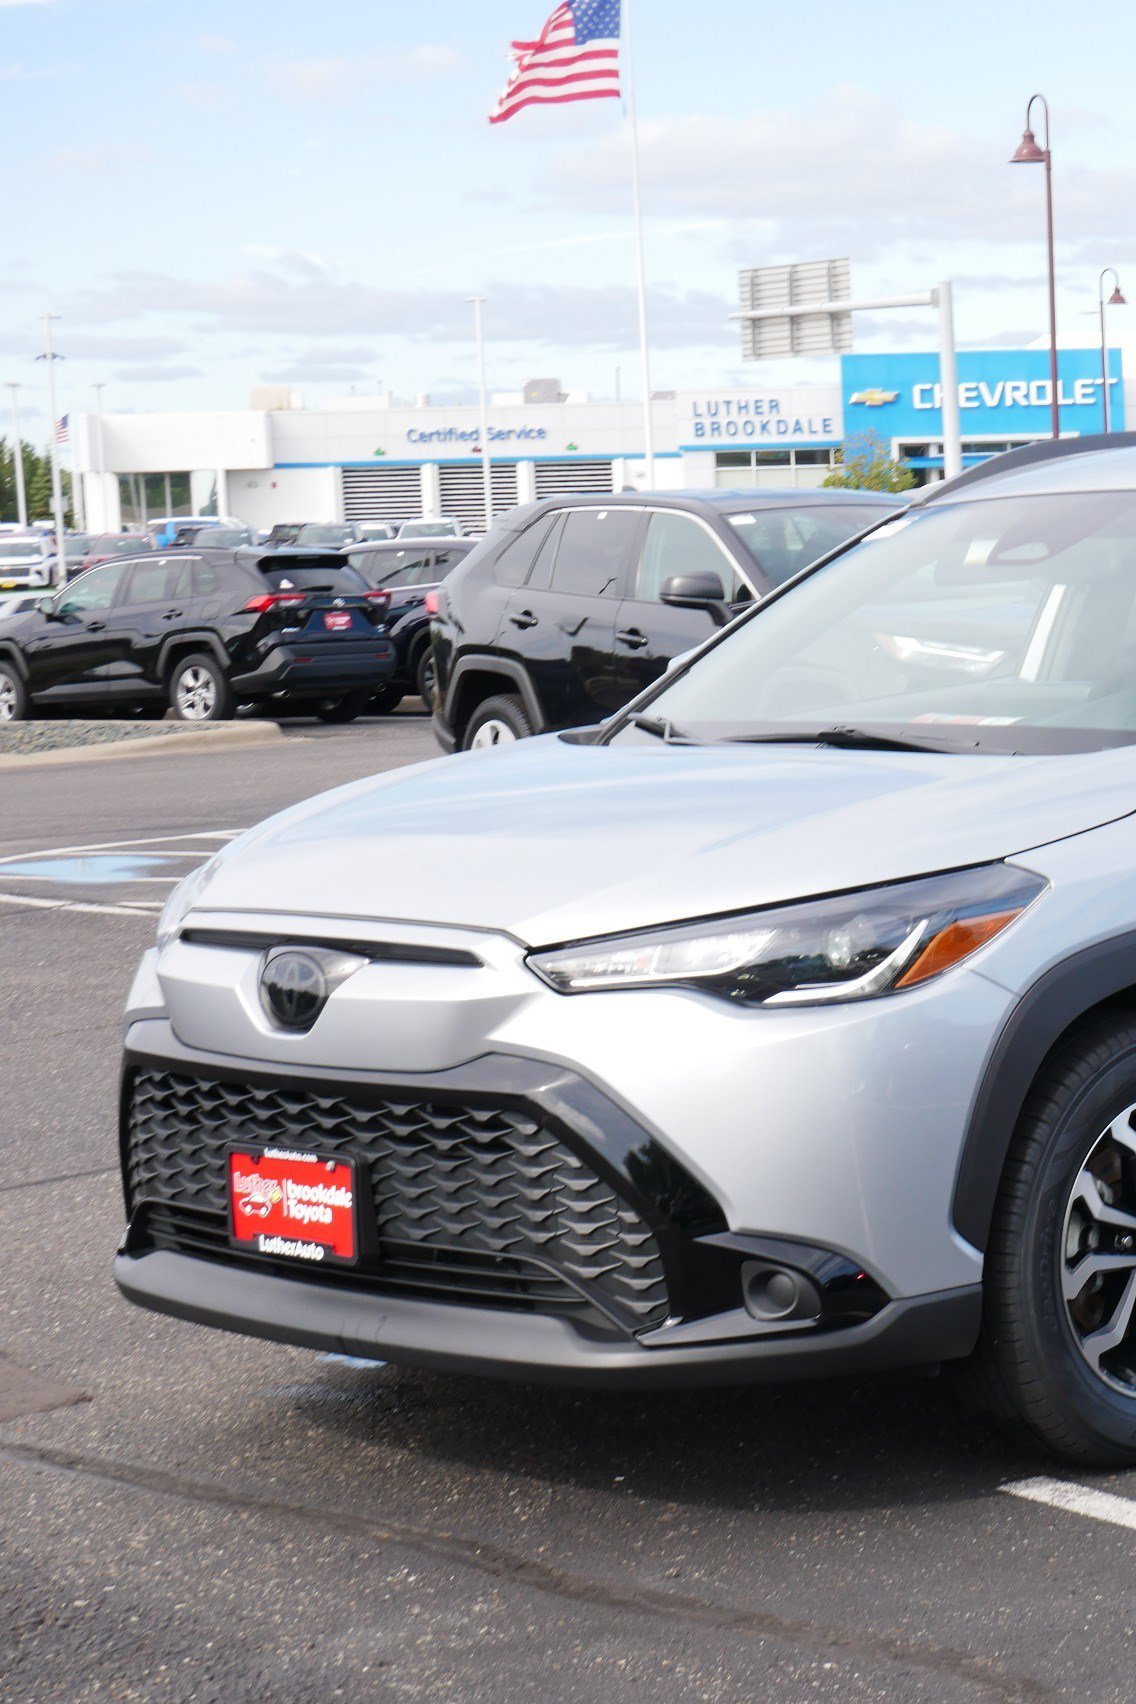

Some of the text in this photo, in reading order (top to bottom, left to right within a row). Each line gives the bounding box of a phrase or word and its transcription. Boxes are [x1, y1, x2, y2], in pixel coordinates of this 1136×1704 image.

[693, 399, 780, 417] LUTHER
[407, 425, 546, 443] Certified Service
[694, 418, 833, 437] BROOKDALE
[286, 1179, 353, 1208] brookdale
[287, 1200, 333, 1225] Toyota
[258, 1234, 325, 1260] LutherAuto
